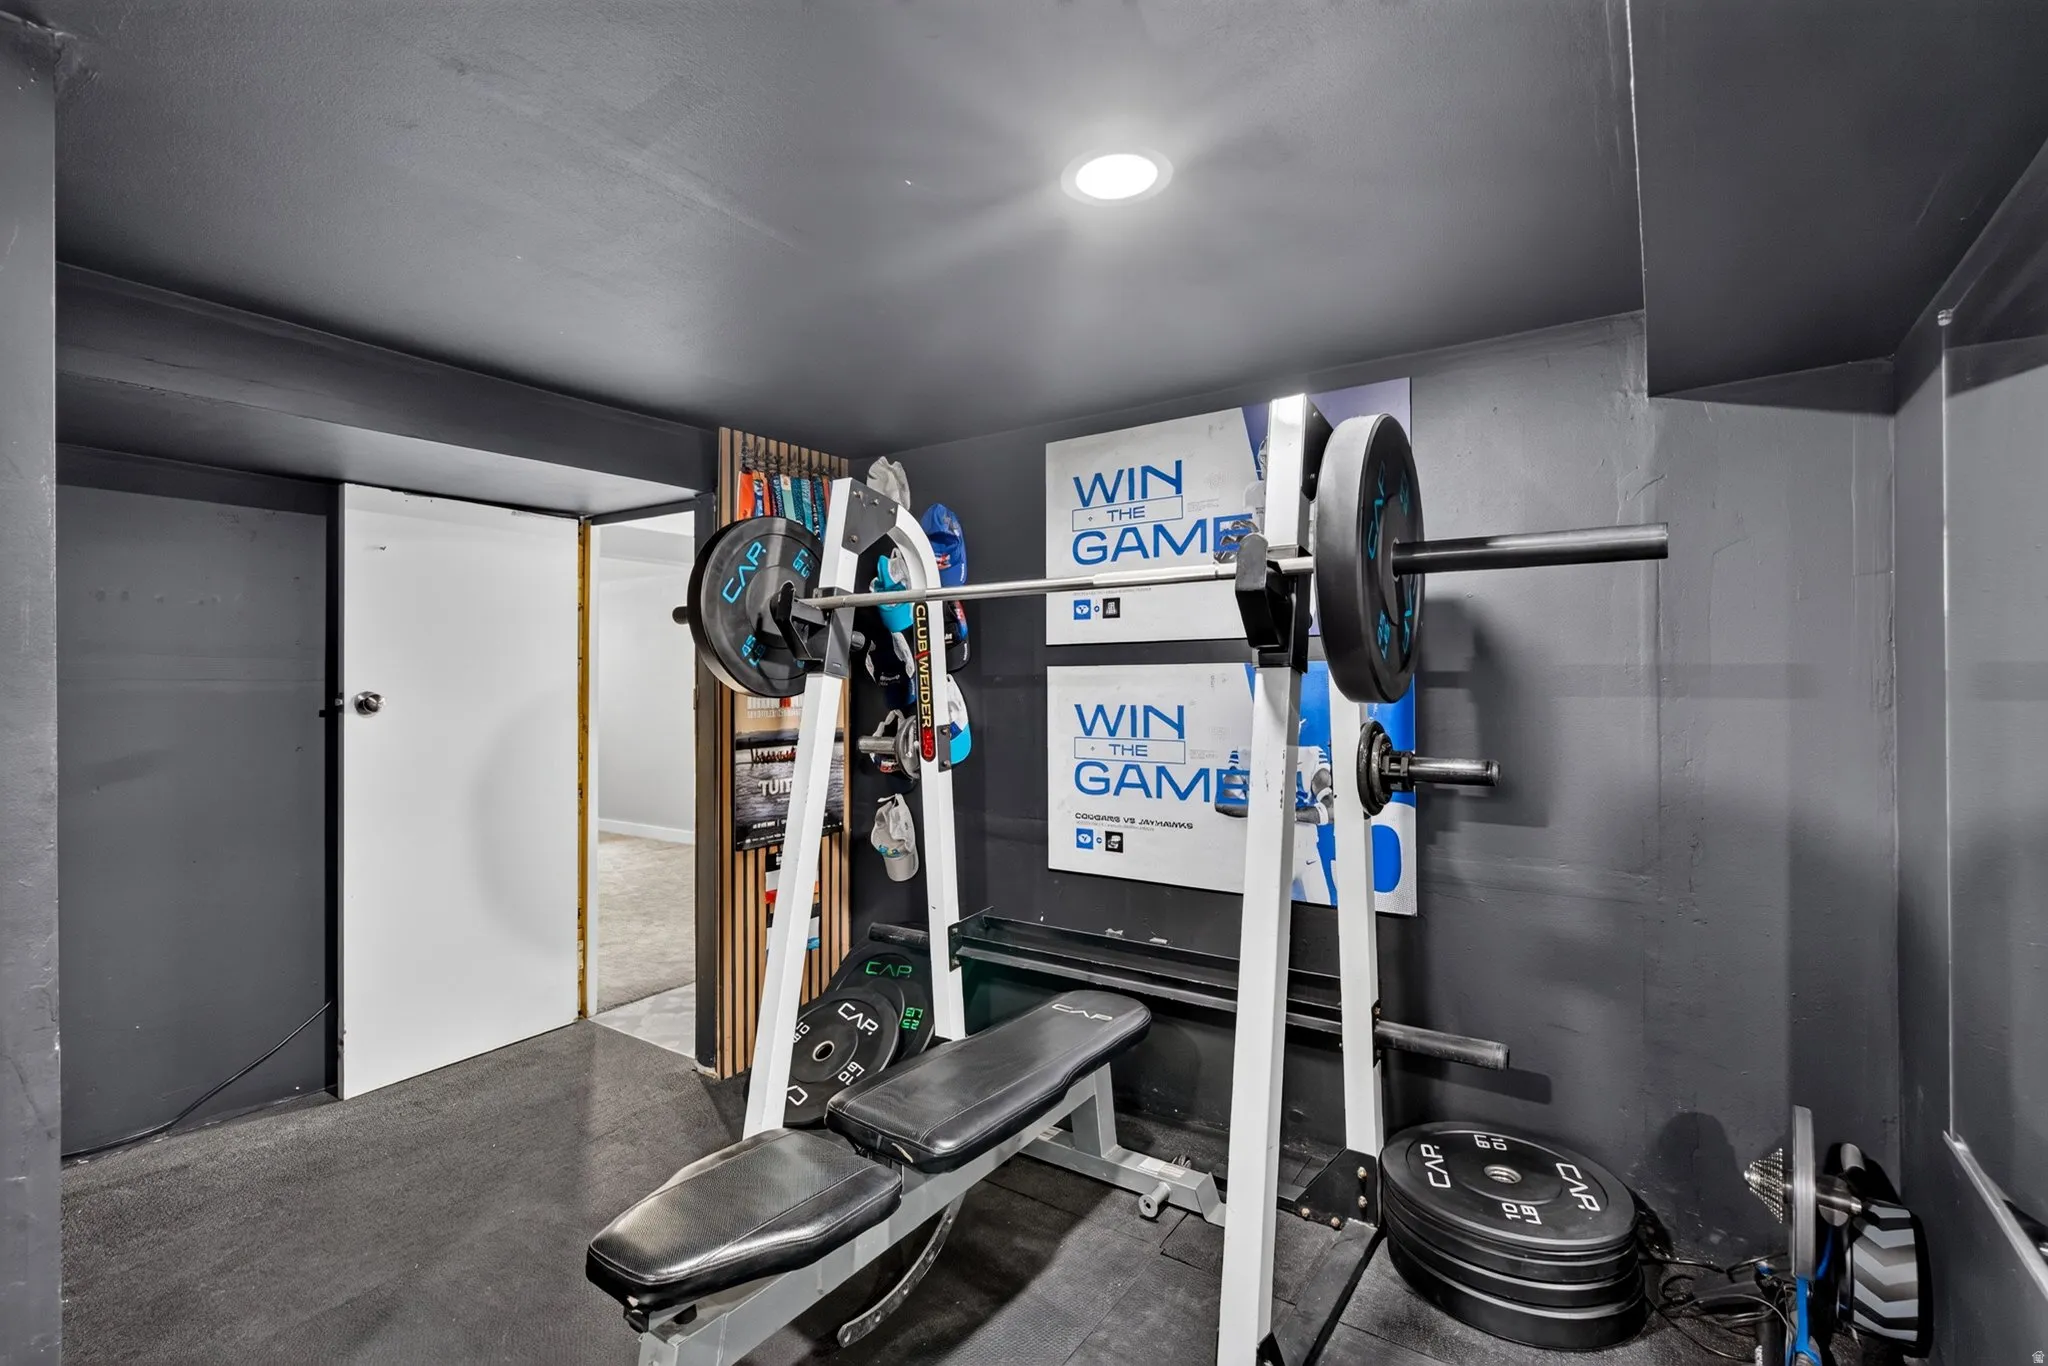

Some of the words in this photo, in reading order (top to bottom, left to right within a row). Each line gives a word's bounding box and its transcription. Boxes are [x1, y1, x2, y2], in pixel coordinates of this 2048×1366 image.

[1073, 460, 1183, 508] WIN
[1107, 505, 1146, 523] THE
[1072, 513, 1253, 566] GAME
[722, 541, 766, 603] CAP
[915, 604, 928, 652] CLUB
[918, 656, 932, 729] WEIDER
[1074, 704, 1185, 740] WIN
[1108, 743, 1148, 758] THE
[1074, 761, 1250, 805] GAME
[1075, 812, 1121, 824] COUGARS
[1138, 819, 1194, 830] JAYHAWKS
[866, 961, 912, 978] CAP
[838, 1002, 879, 1036] CAP
[905, 1007, 923, 1019] LB
[1052, 1003, 1113, 1021] CAP
[838, 1071, 855, 1086] 10
[847, 1061, 866, 1078] LB
[1474, 1134, 1492, 1150] LB
[1491, 1137, 1508, 1151] 10
[1420, 1143, 1452, 1189] CAP
[1556, 1162, 1602, 1212] CAP
[1502, 1202, 1521, 1220] 10
[1520, 1205, 1543, 1225] LB
